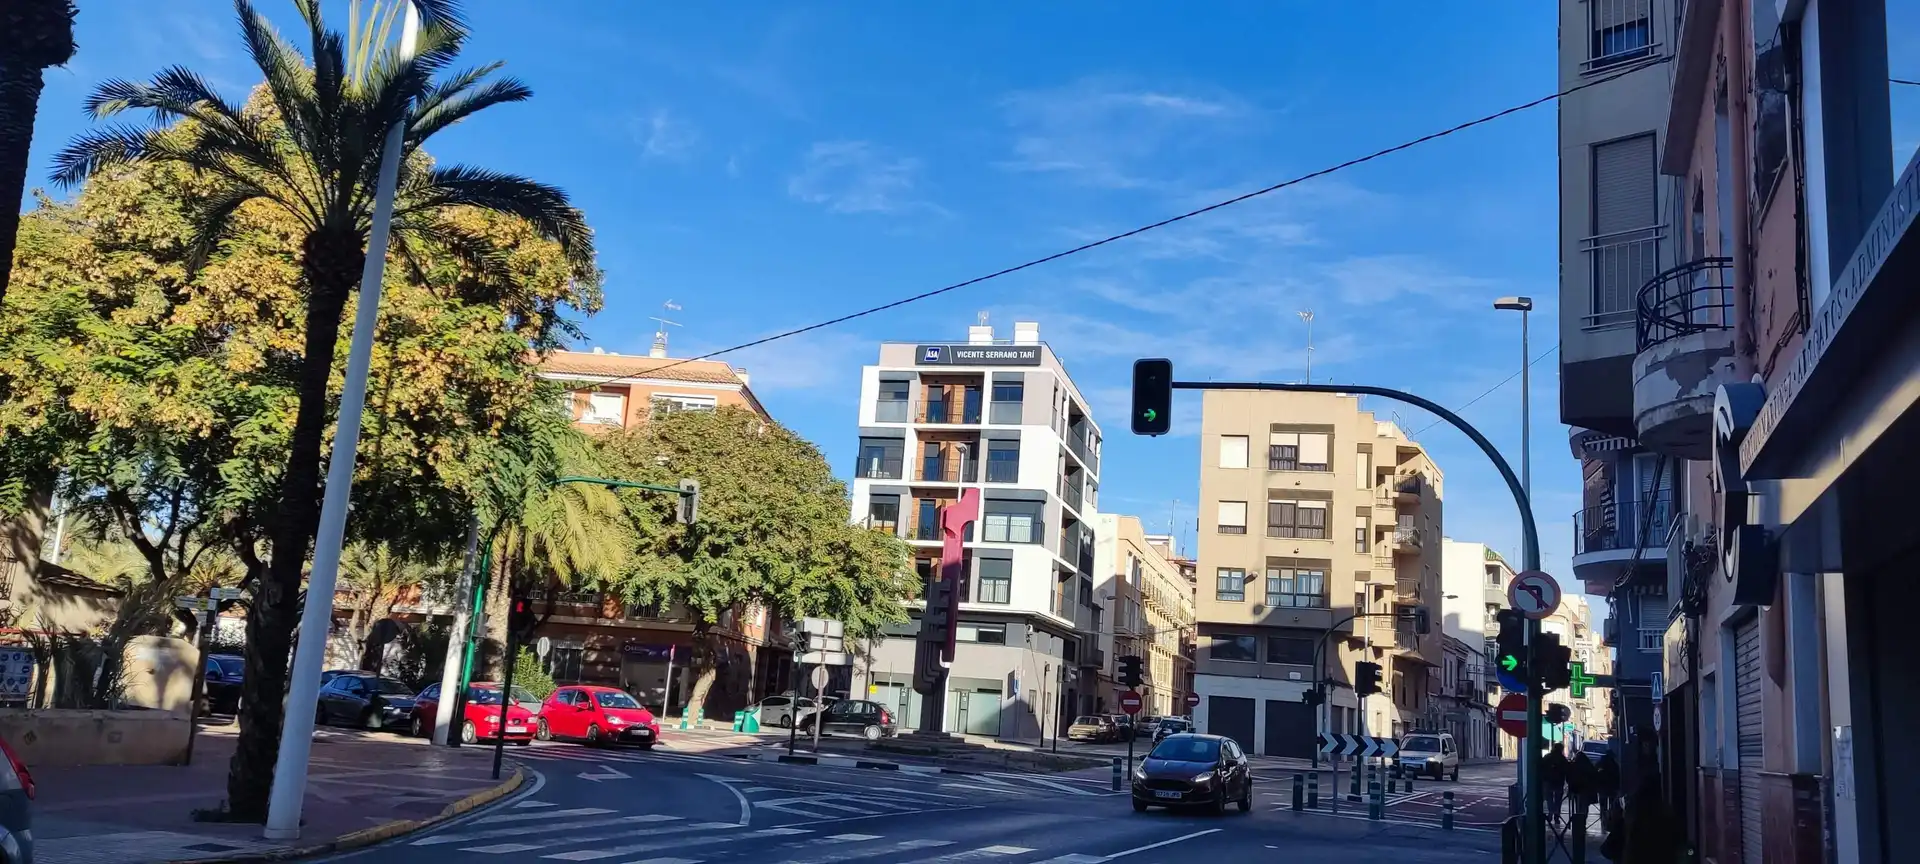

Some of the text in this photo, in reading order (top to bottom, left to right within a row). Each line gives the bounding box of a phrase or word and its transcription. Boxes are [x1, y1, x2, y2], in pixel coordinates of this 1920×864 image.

[956, 349, 1036, 359] VICENTE SERRANO TARÍ
